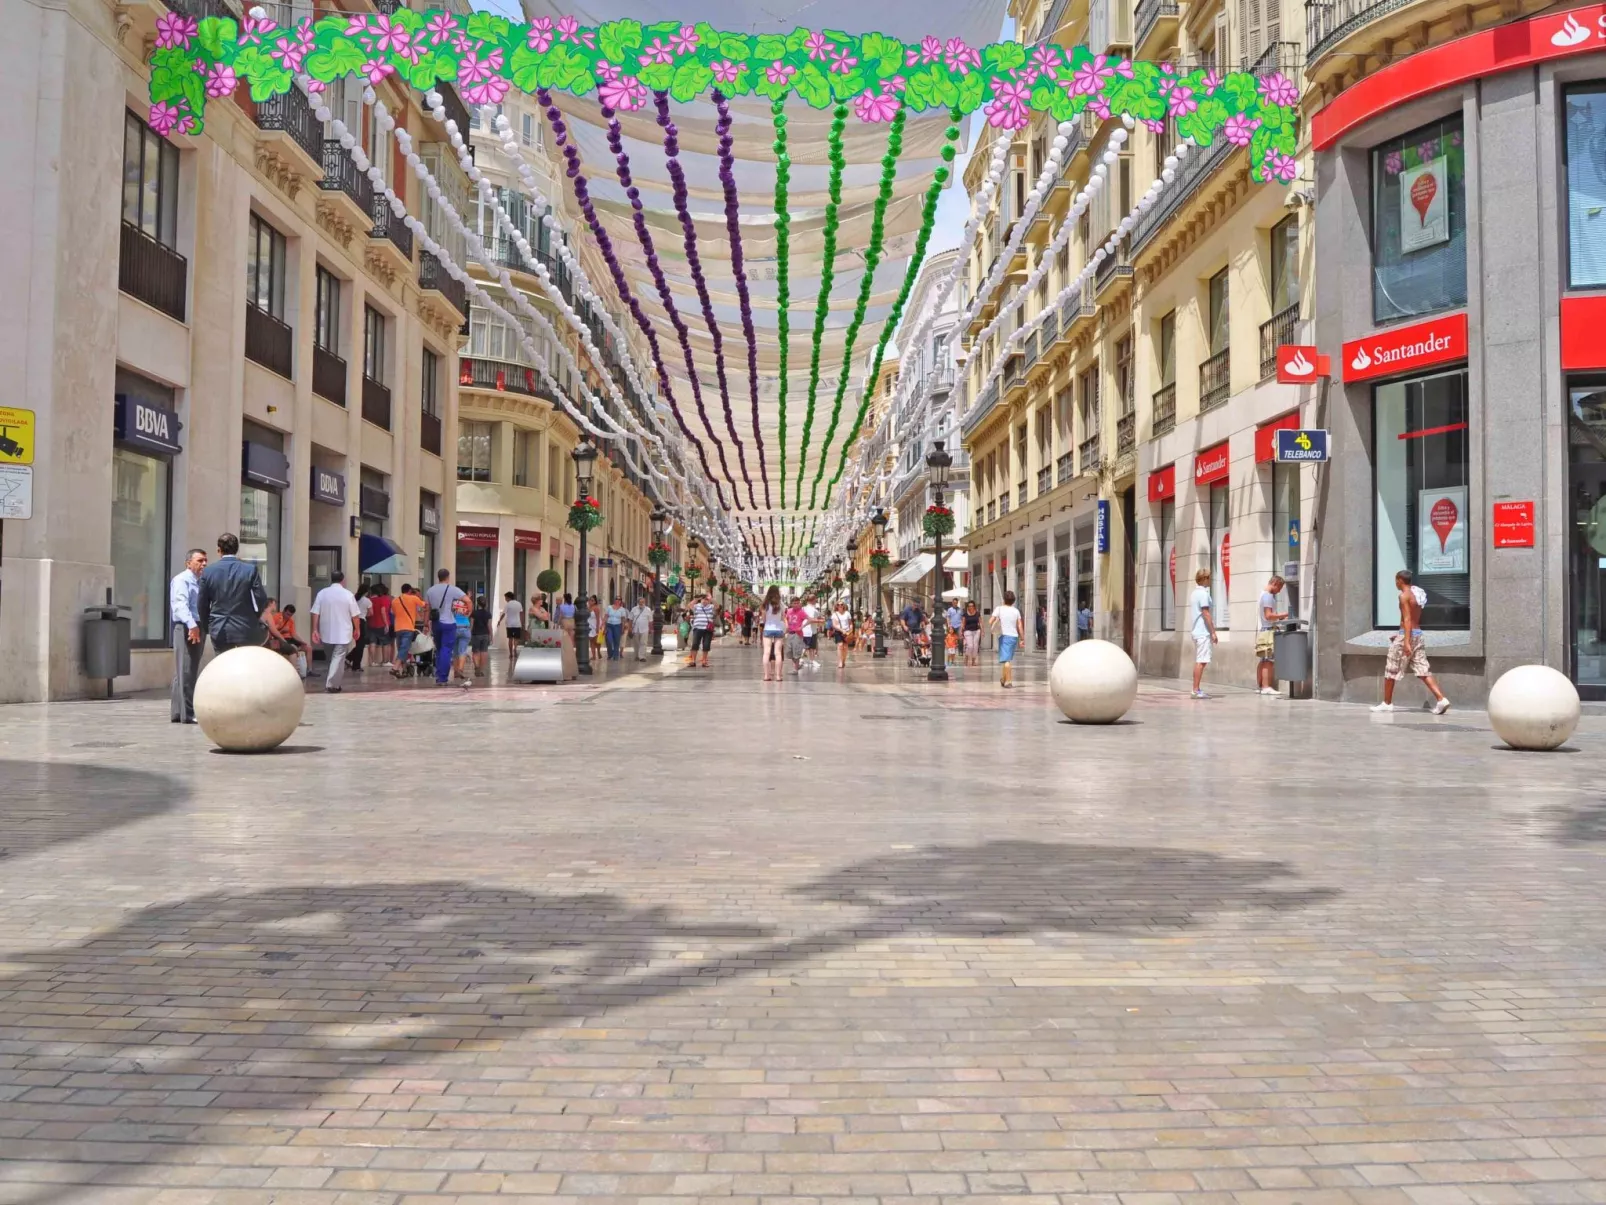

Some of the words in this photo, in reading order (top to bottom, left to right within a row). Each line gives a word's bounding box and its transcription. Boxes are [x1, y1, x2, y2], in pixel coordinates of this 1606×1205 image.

[1374, 332, 1451, 365] Santander
[136, 405, 169, 440] BBVA
[1203, 454, 1226, 474] Santander
[1284, 450, 1322, 459] TELEBANCO
[320, 473, 338, 496] BBVA
